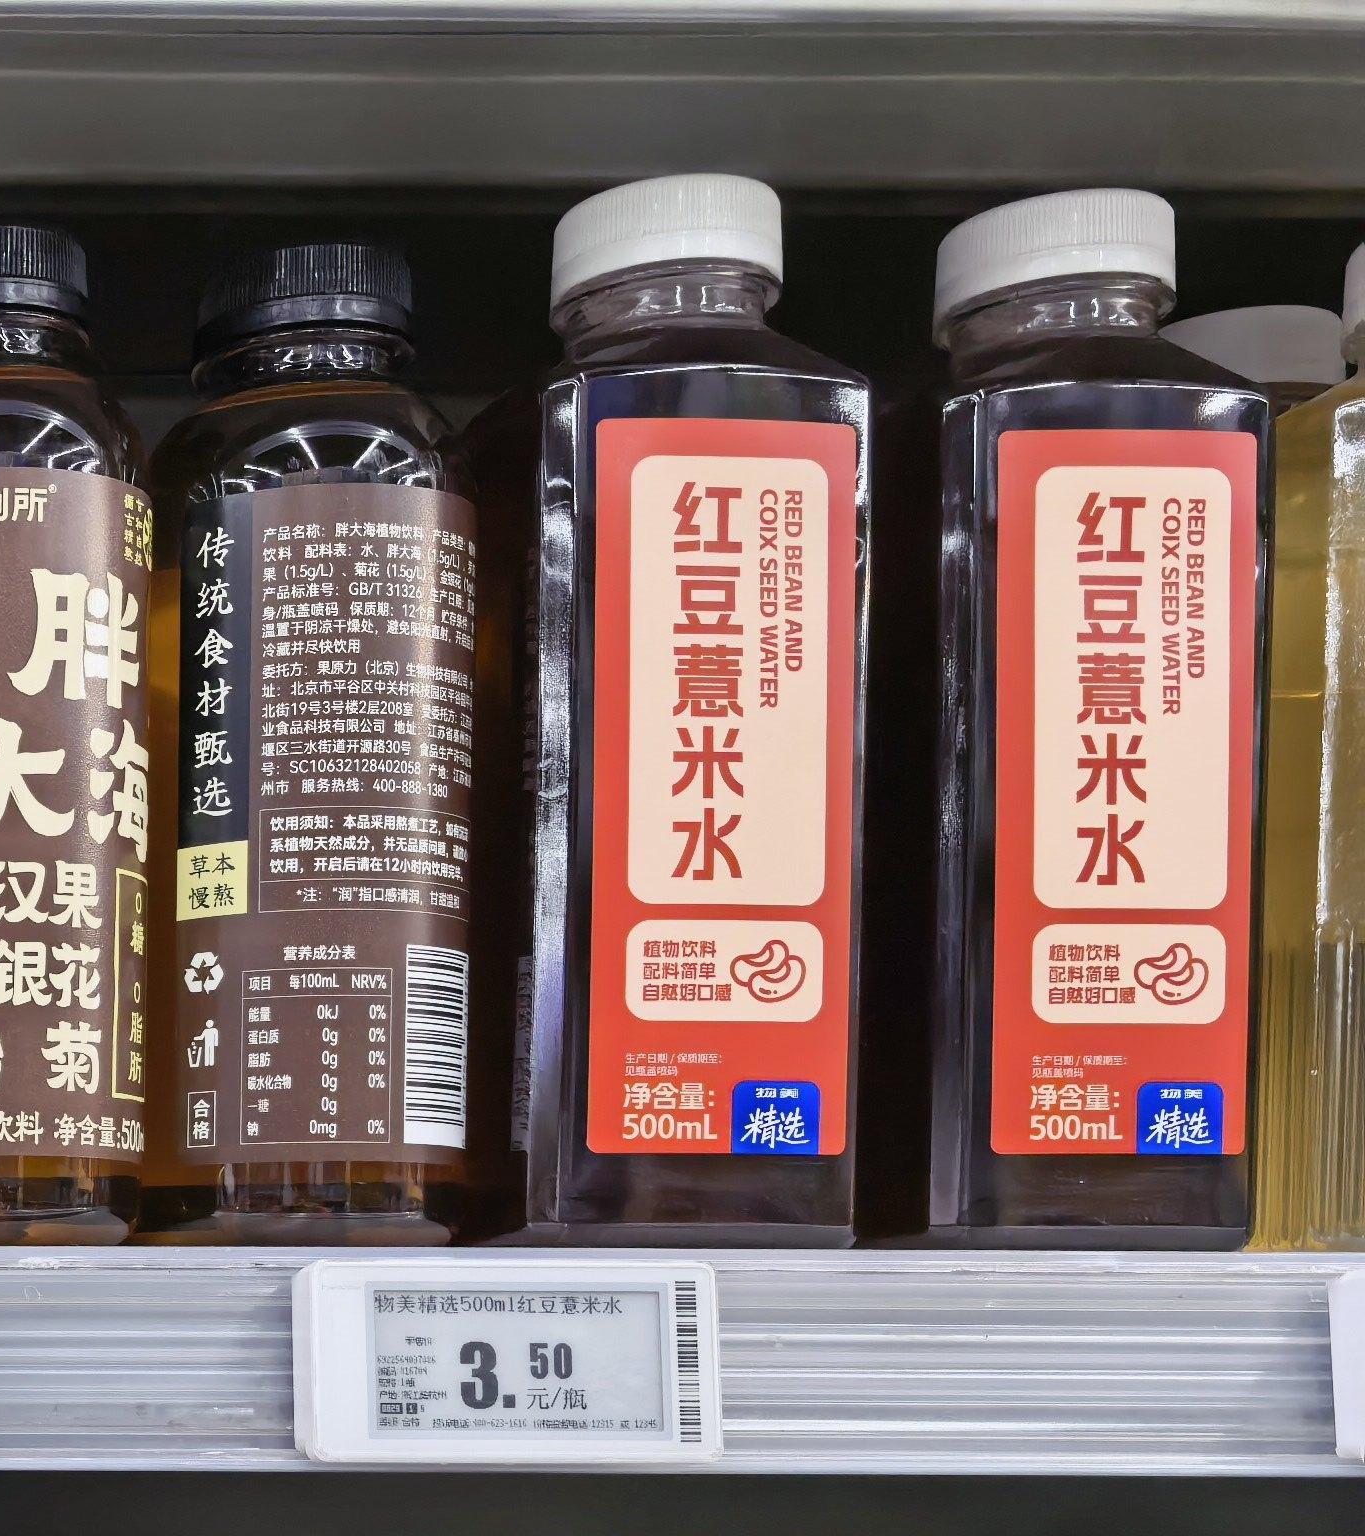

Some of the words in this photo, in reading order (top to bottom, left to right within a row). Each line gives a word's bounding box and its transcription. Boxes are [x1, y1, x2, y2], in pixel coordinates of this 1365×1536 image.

[760, 489, 778, 550] COIX
[785, 490, 803, 538] RED
[1162, 498, 1181, 560] COIX
[1187, 498, 1206, 546] RED
[760, 558, 778, 618] SEED
[785, 546, 803, 611] BEAN
[1161, 567, 1179, 626] SEED
[1187, 554, 1204, 619] BEAN
[8, 568, 139, 710] 胖
[785, 619, 803, 672] AND
[1187, 626, 1205, 679] AND
[193, 527, 234, 816] 传统食材甄选
[672, 480, 744, 882] 红豆薏米水
[760, 625, 778, 708] WATER
[1076, 491, 1147, 886] 红豆薏米水
[1162, 633, 1181, 715] WATER
[643, 940, 717, 958] 植物饮料
[643, 963, 716, 980] 配料简单
[643, 984, 732, 1002] 自然好口感
[1049, 987, 1135, 1004] 自然好口感
[623, 1083, 715, 1110] 净含量:
[1030, 1084, 1119, 1110] 净含量:
[622, 1114, 718, 1140] 500mL
[740, 1104, 810, 1148] 精选
[1029, 1115, 1123, 1141] 500mL
[1146, 1105, 1214, 1148] 精选
